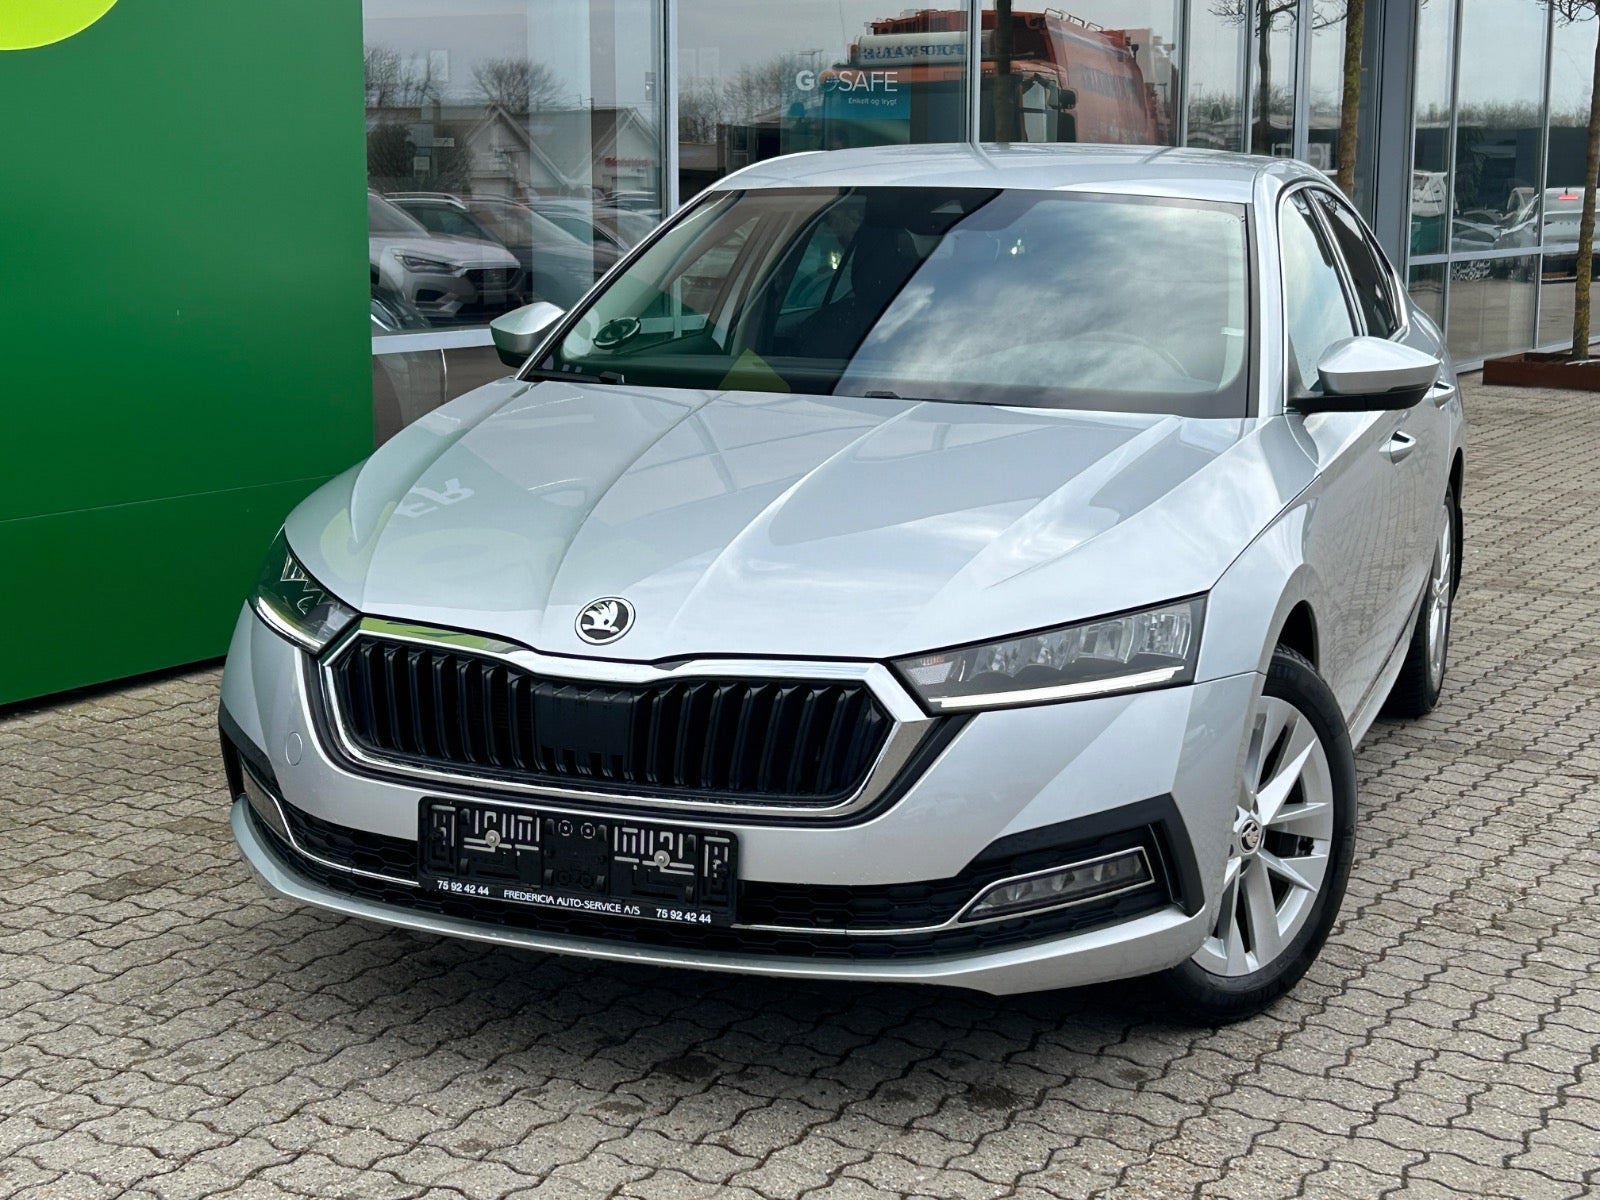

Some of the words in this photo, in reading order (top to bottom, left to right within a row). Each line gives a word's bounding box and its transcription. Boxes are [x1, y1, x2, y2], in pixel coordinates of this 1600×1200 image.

[848, 97, 869, 105] Enkelt
[882, 98, 897, 106] trygt
[437, 880, 449, 890] 75
[450, 882, 463, 892] 92
[464, 884, 476, 894] 42
[477, 885, 489, 896] 44
[504, 889, 554, 905] FREDERICIA
[556, 893, 621, 914] AUTO-SERVICE
[624, 905, 640, 915] A/S
[656, 908, 668, 918] 75
[670, 910, 682, 920] 92
[684, 911, 697, 922] 42
[698, 913, 711, 923] 44
